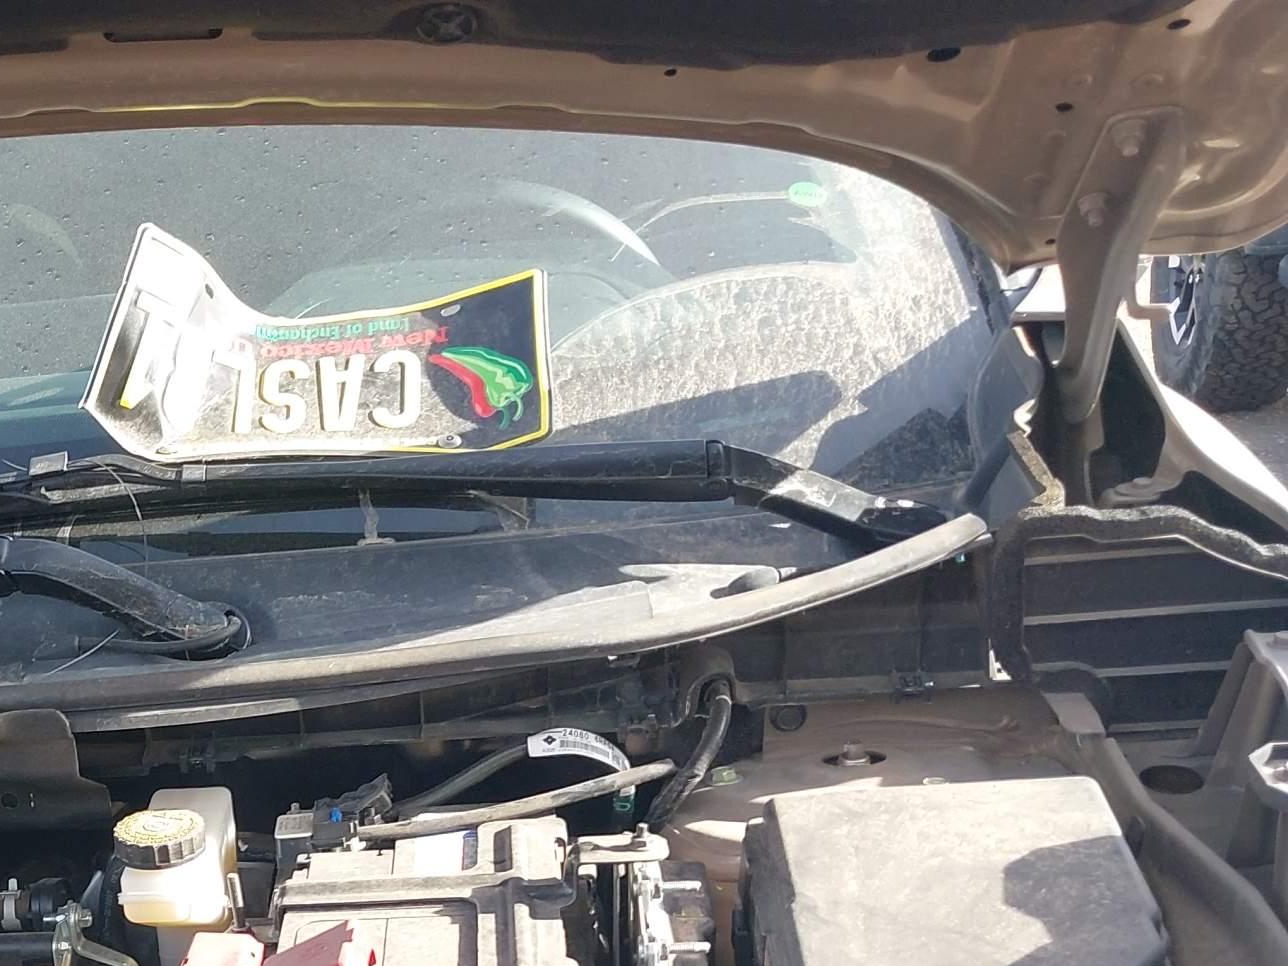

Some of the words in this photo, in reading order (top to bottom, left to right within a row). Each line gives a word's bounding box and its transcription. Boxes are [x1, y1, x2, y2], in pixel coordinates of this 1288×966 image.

[348, 320, 362, 334] of
[380, 326, 449, 349] New
[262, 336, 375, 358] Mexico
[562, 728, 590, 740] 24080
